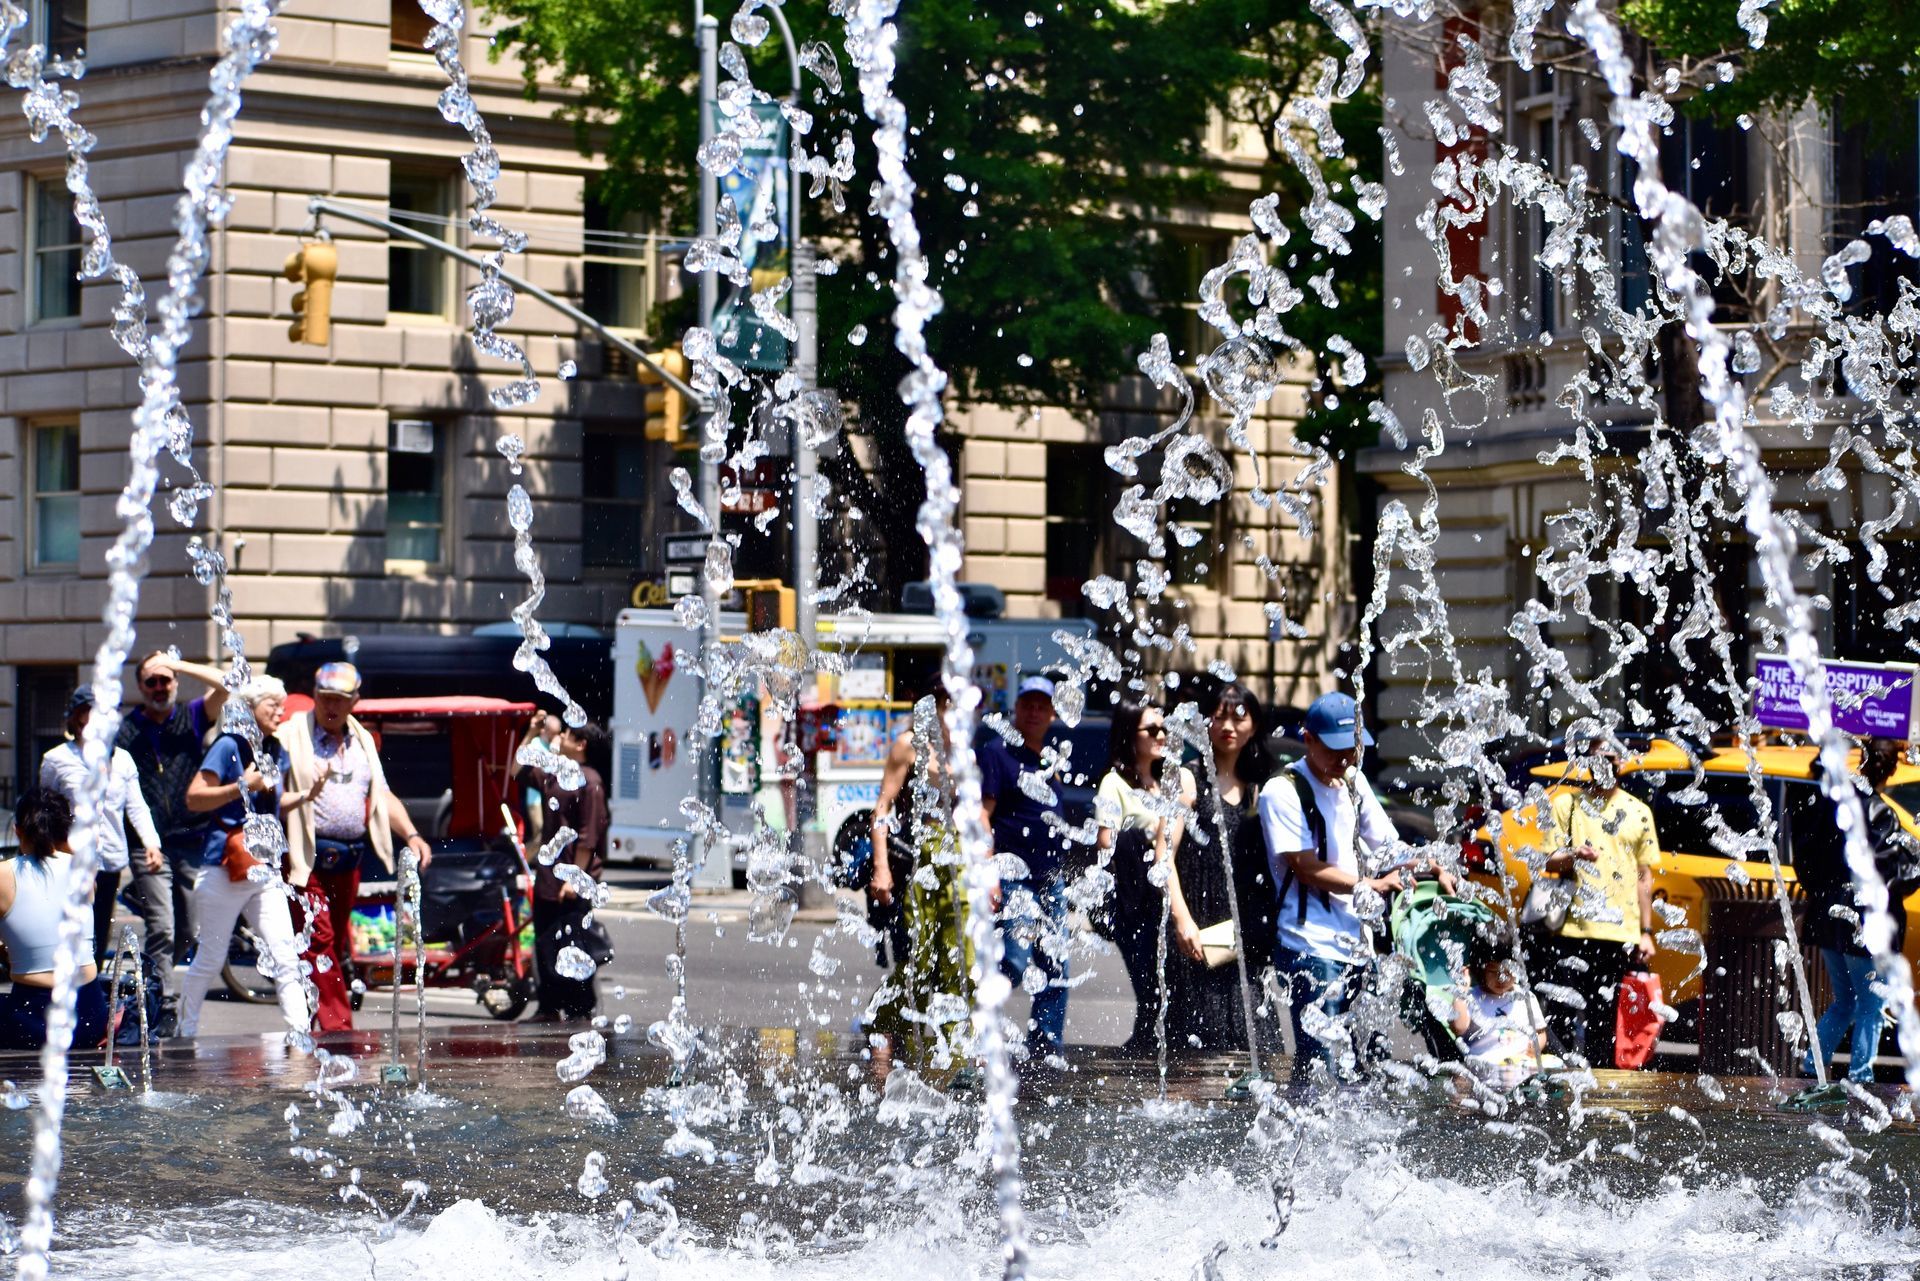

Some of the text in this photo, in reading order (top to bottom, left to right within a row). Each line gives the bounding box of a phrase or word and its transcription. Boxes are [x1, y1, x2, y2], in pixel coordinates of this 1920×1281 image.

[1762, 666, 1791, 683] THE
[1824, 670, 1884, 691] OSPITAL
[1761, 682, 1777, 698] IN
